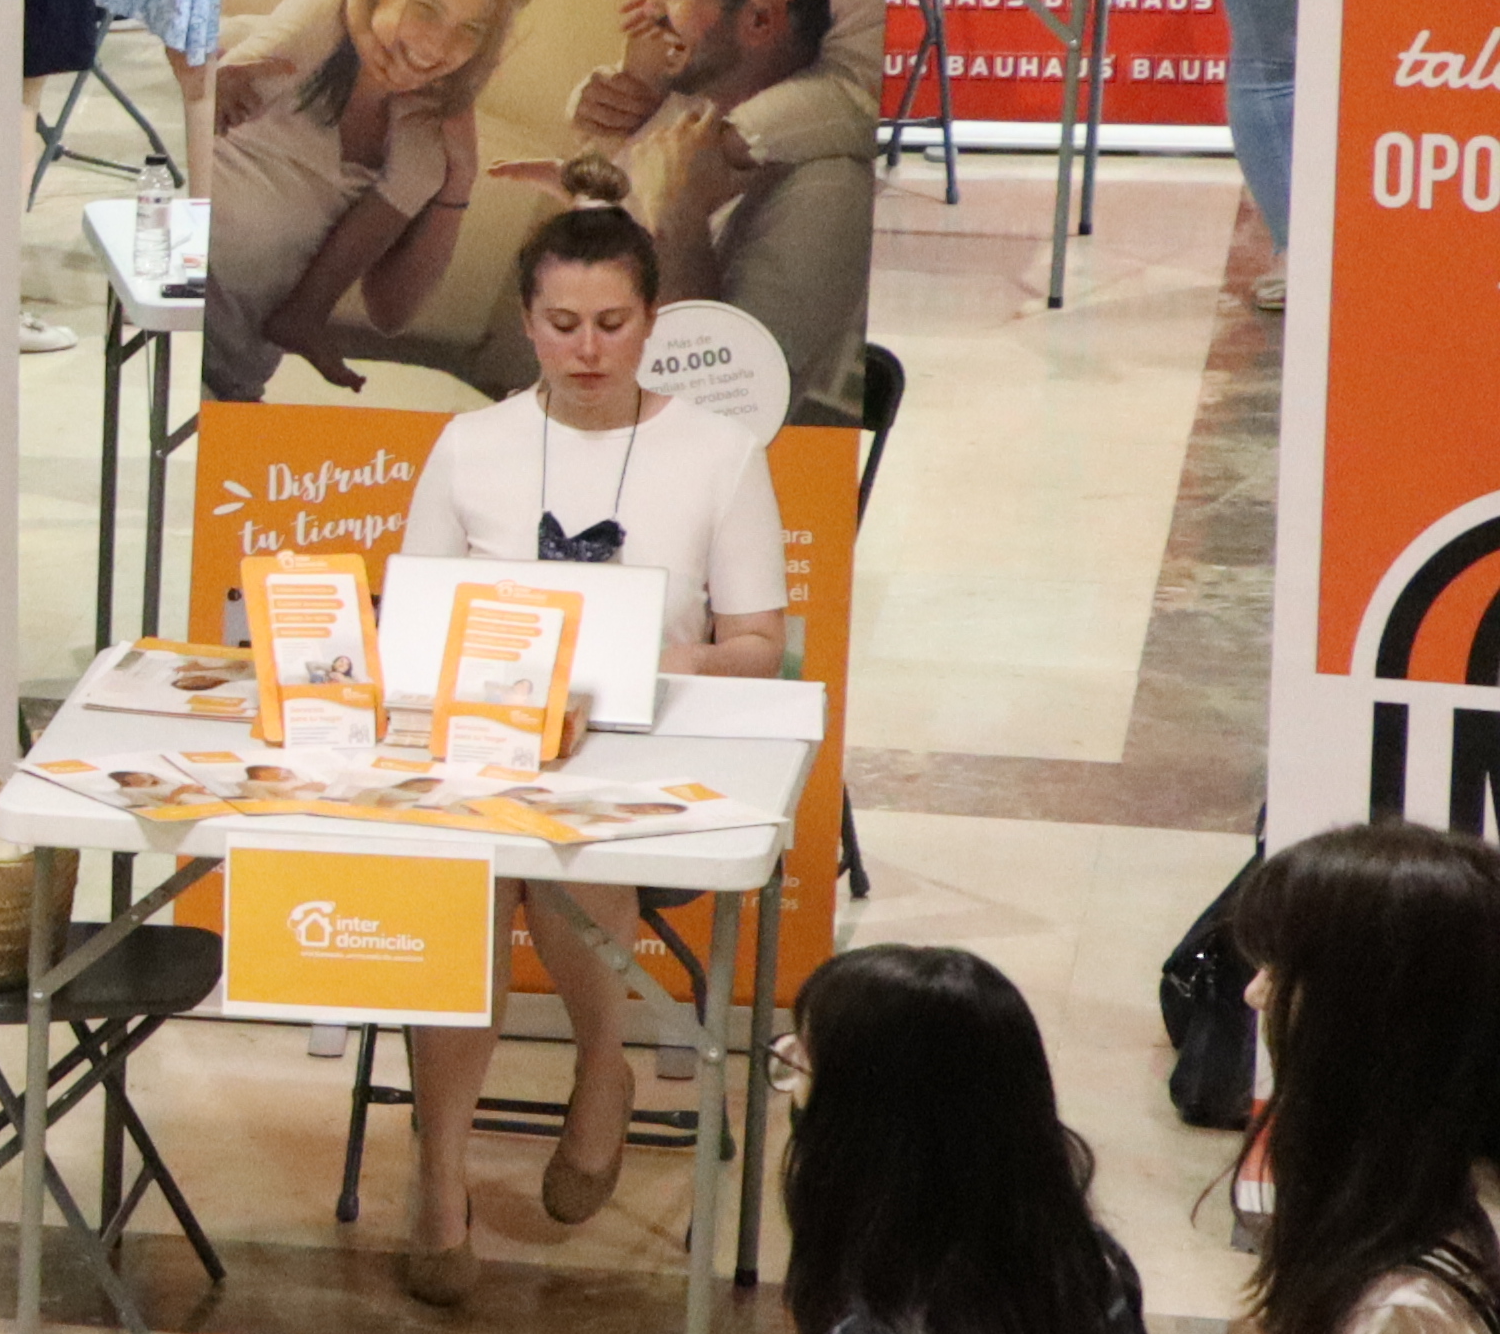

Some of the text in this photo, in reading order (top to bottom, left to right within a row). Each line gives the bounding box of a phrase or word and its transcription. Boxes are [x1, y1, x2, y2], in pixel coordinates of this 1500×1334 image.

[651, 347, 732, 375] 40.000
[708, 369, 755, 385] España
[268, 449, 415, 503] Disfruta
[238, 510, 409, 555] tu tiempo
[780, 529, 813, 545] ara
[336, 915, 380, 932] inter
[336, 933, 425, 952] domicilio
